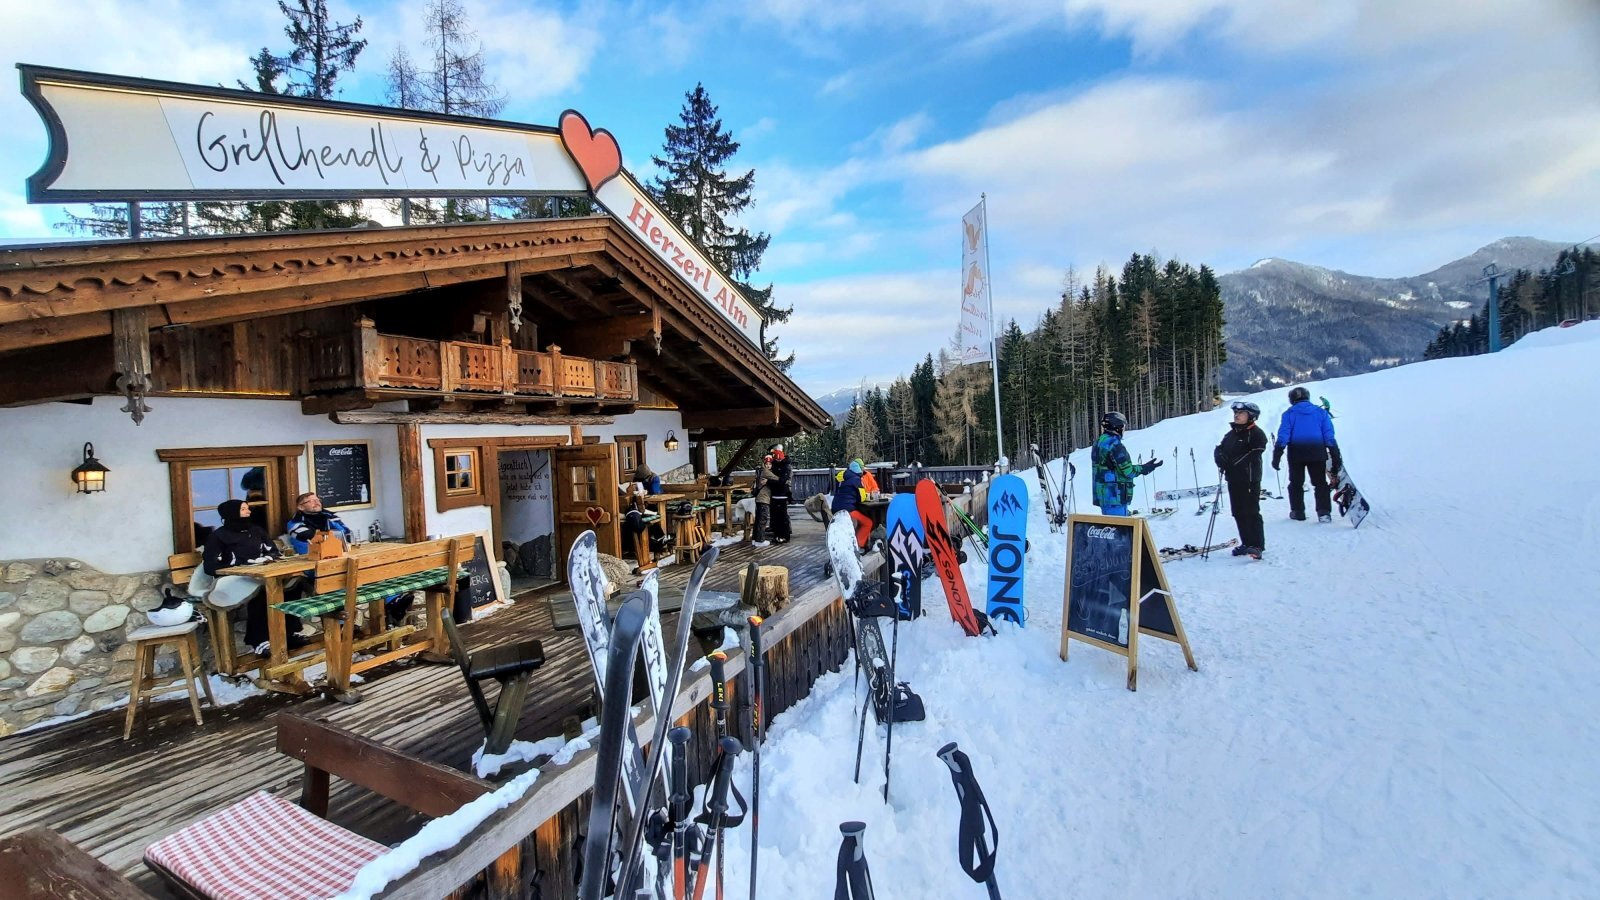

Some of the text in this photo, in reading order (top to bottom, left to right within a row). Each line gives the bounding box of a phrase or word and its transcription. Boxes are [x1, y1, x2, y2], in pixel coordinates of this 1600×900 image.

[196, 110, 528, 186] Grillhendl & Pizza
[626, 197, 749, 329] Herzerl Alm
[716, 682, 724, 702] LEKI
